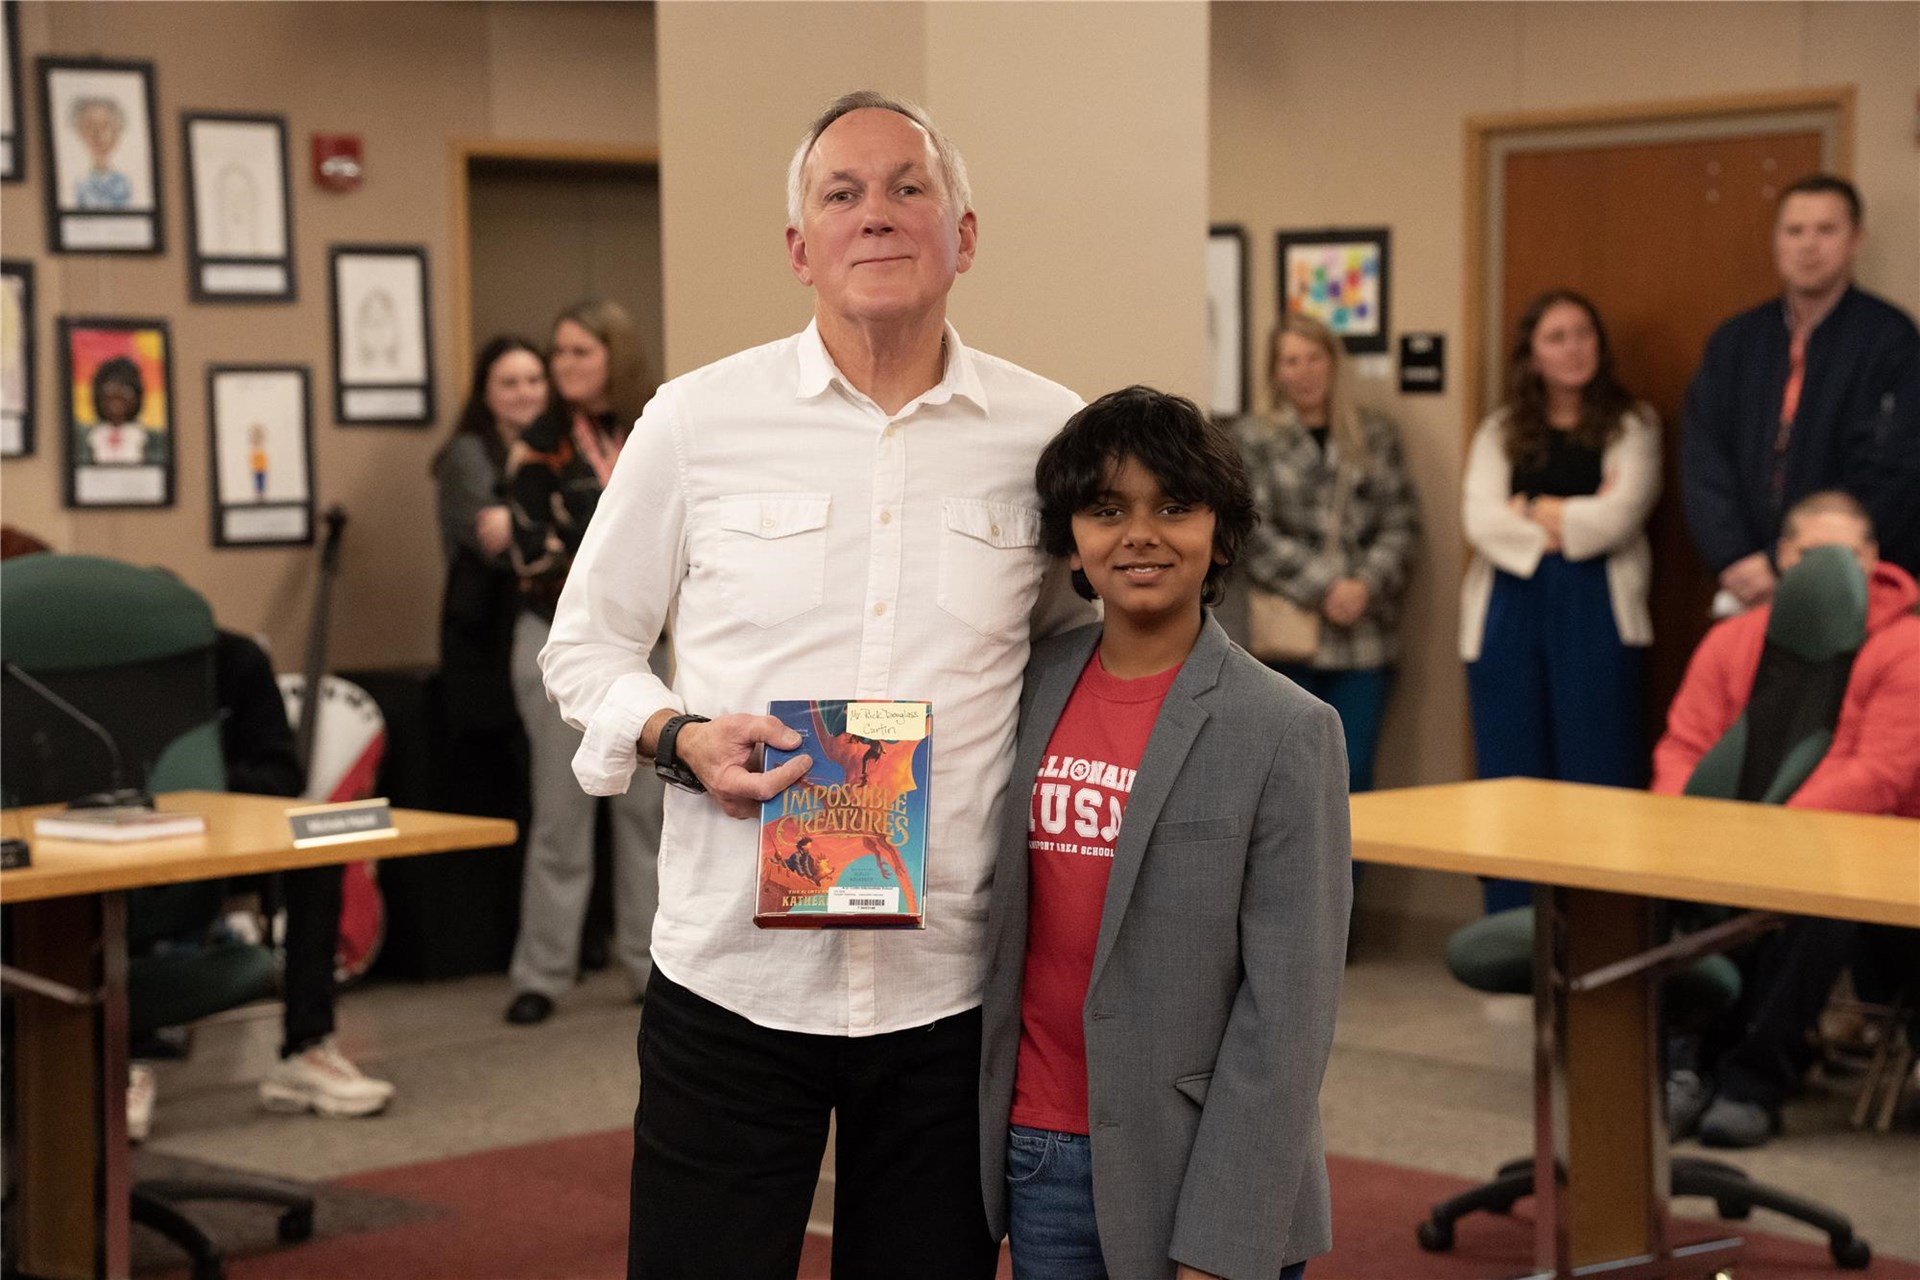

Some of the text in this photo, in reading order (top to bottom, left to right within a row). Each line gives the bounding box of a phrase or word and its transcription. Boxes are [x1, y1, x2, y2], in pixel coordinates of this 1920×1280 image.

[782, 783, 908, 816] IMPOSSIBLE
[776, 808, 909, 847] CREATURES
[1080, 845, 1115, 858] SCHOOL
[782, 895, 828, 907] KATHER
